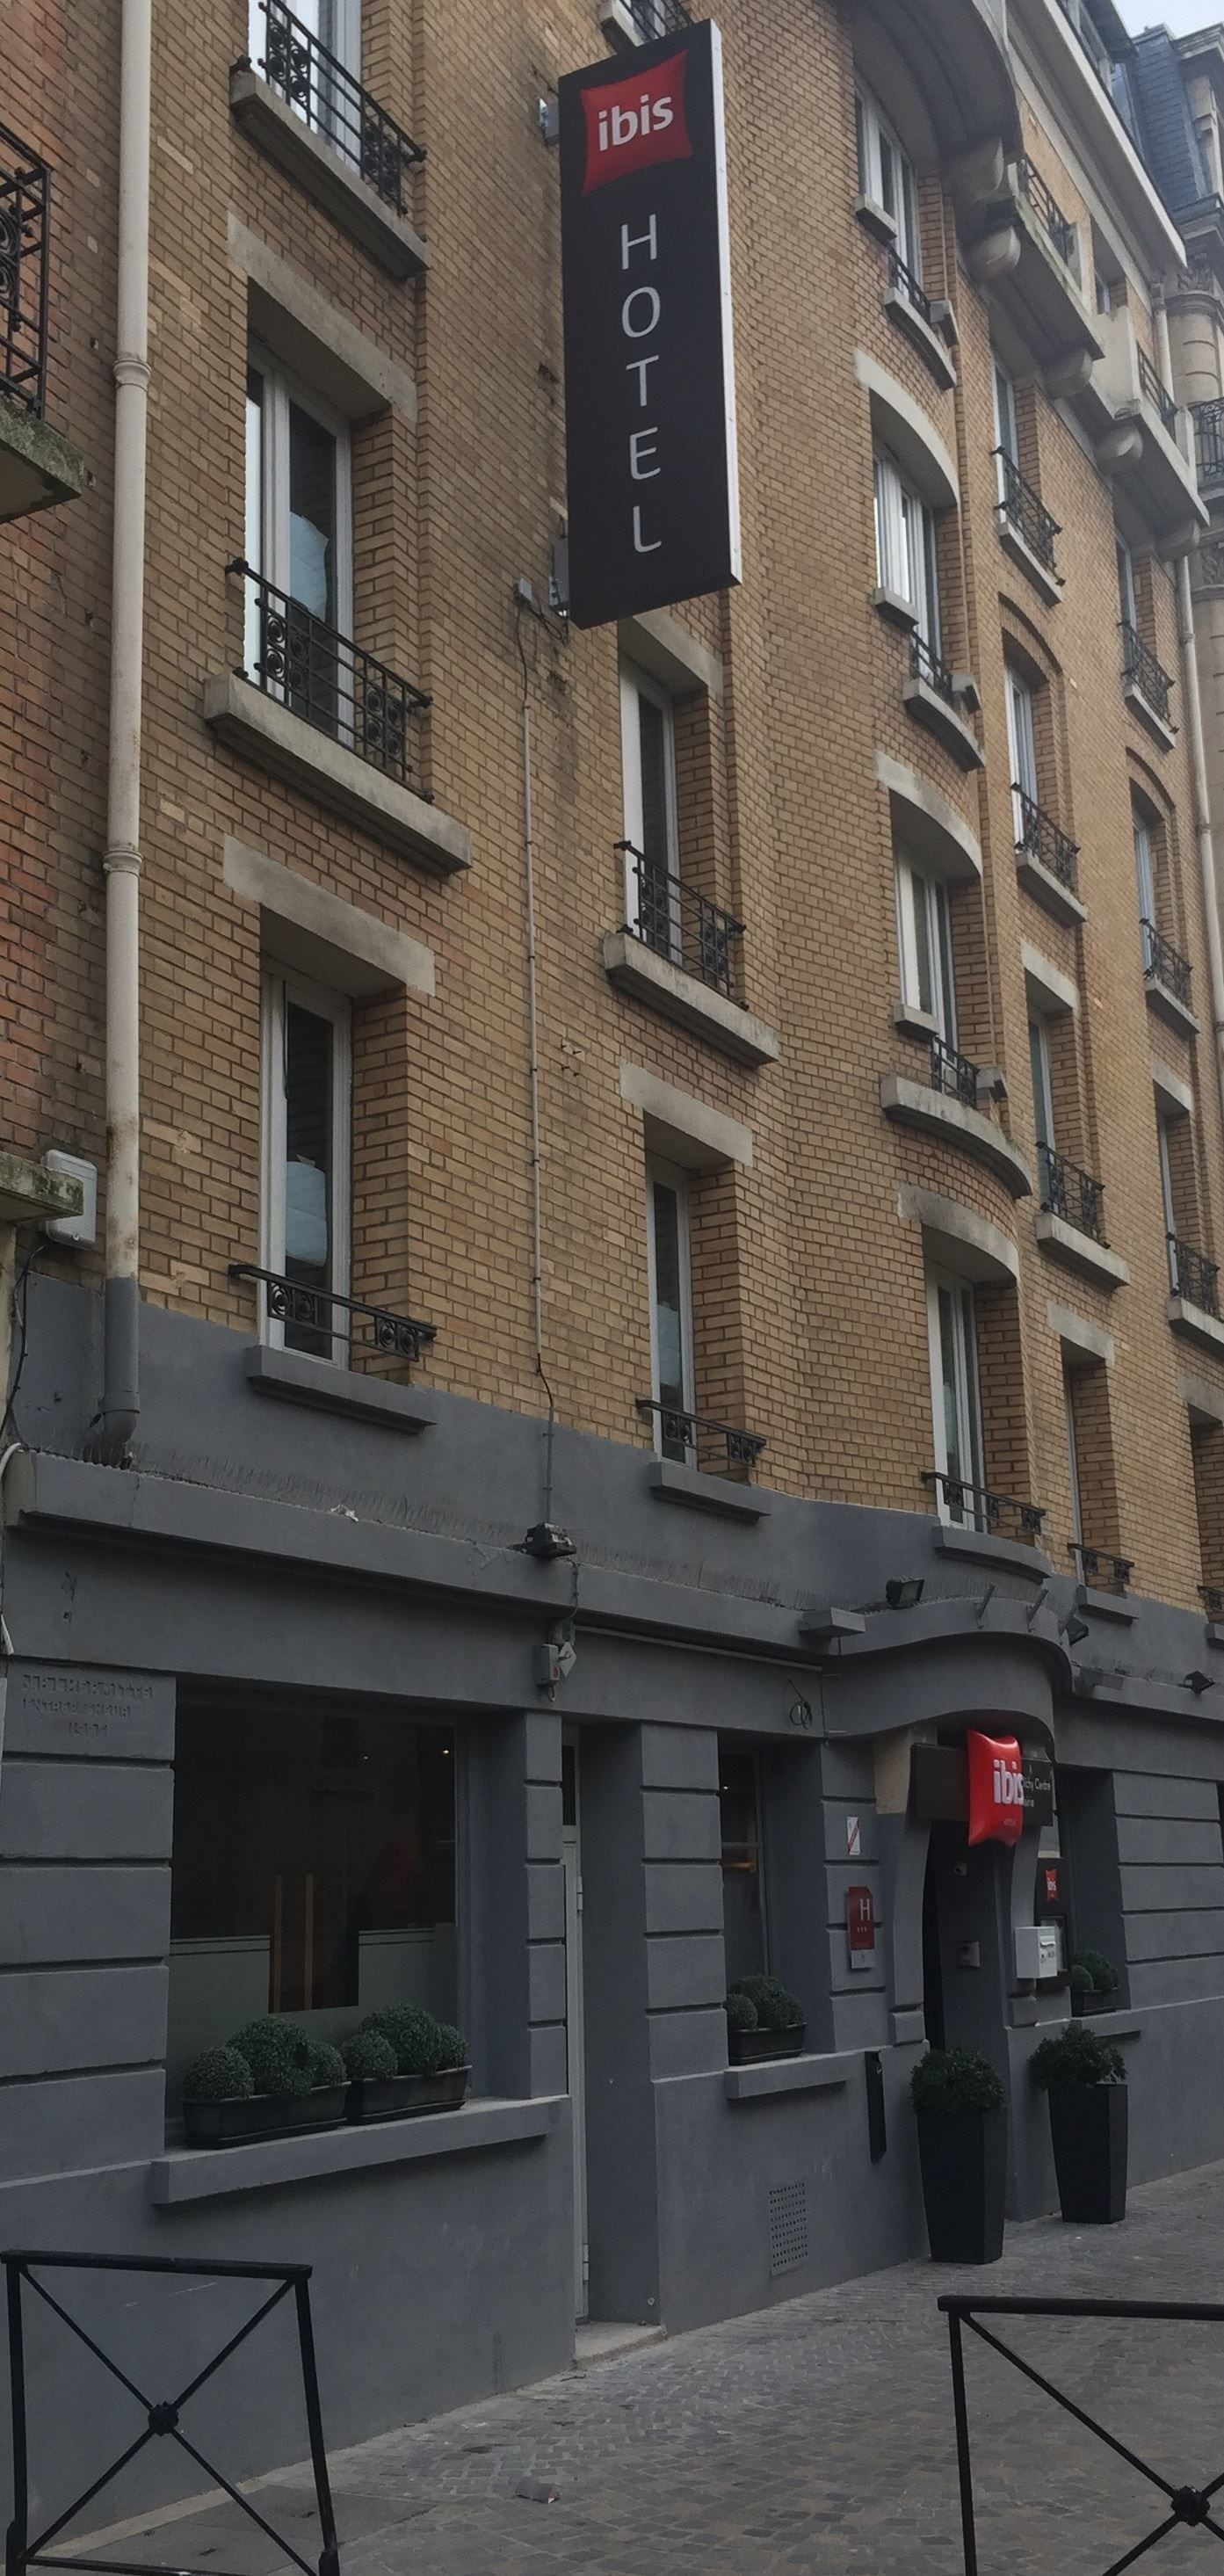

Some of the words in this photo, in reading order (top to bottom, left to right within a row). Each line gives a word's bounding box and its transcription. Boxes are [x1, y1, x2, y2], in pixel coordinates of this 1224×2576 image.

[598, 92, 674, 151] ibis
[619, 213, 662, 555] HOTEL
[993, 1759, 1025, 1806] ibis
[859, 1898, 871, 1920] H
